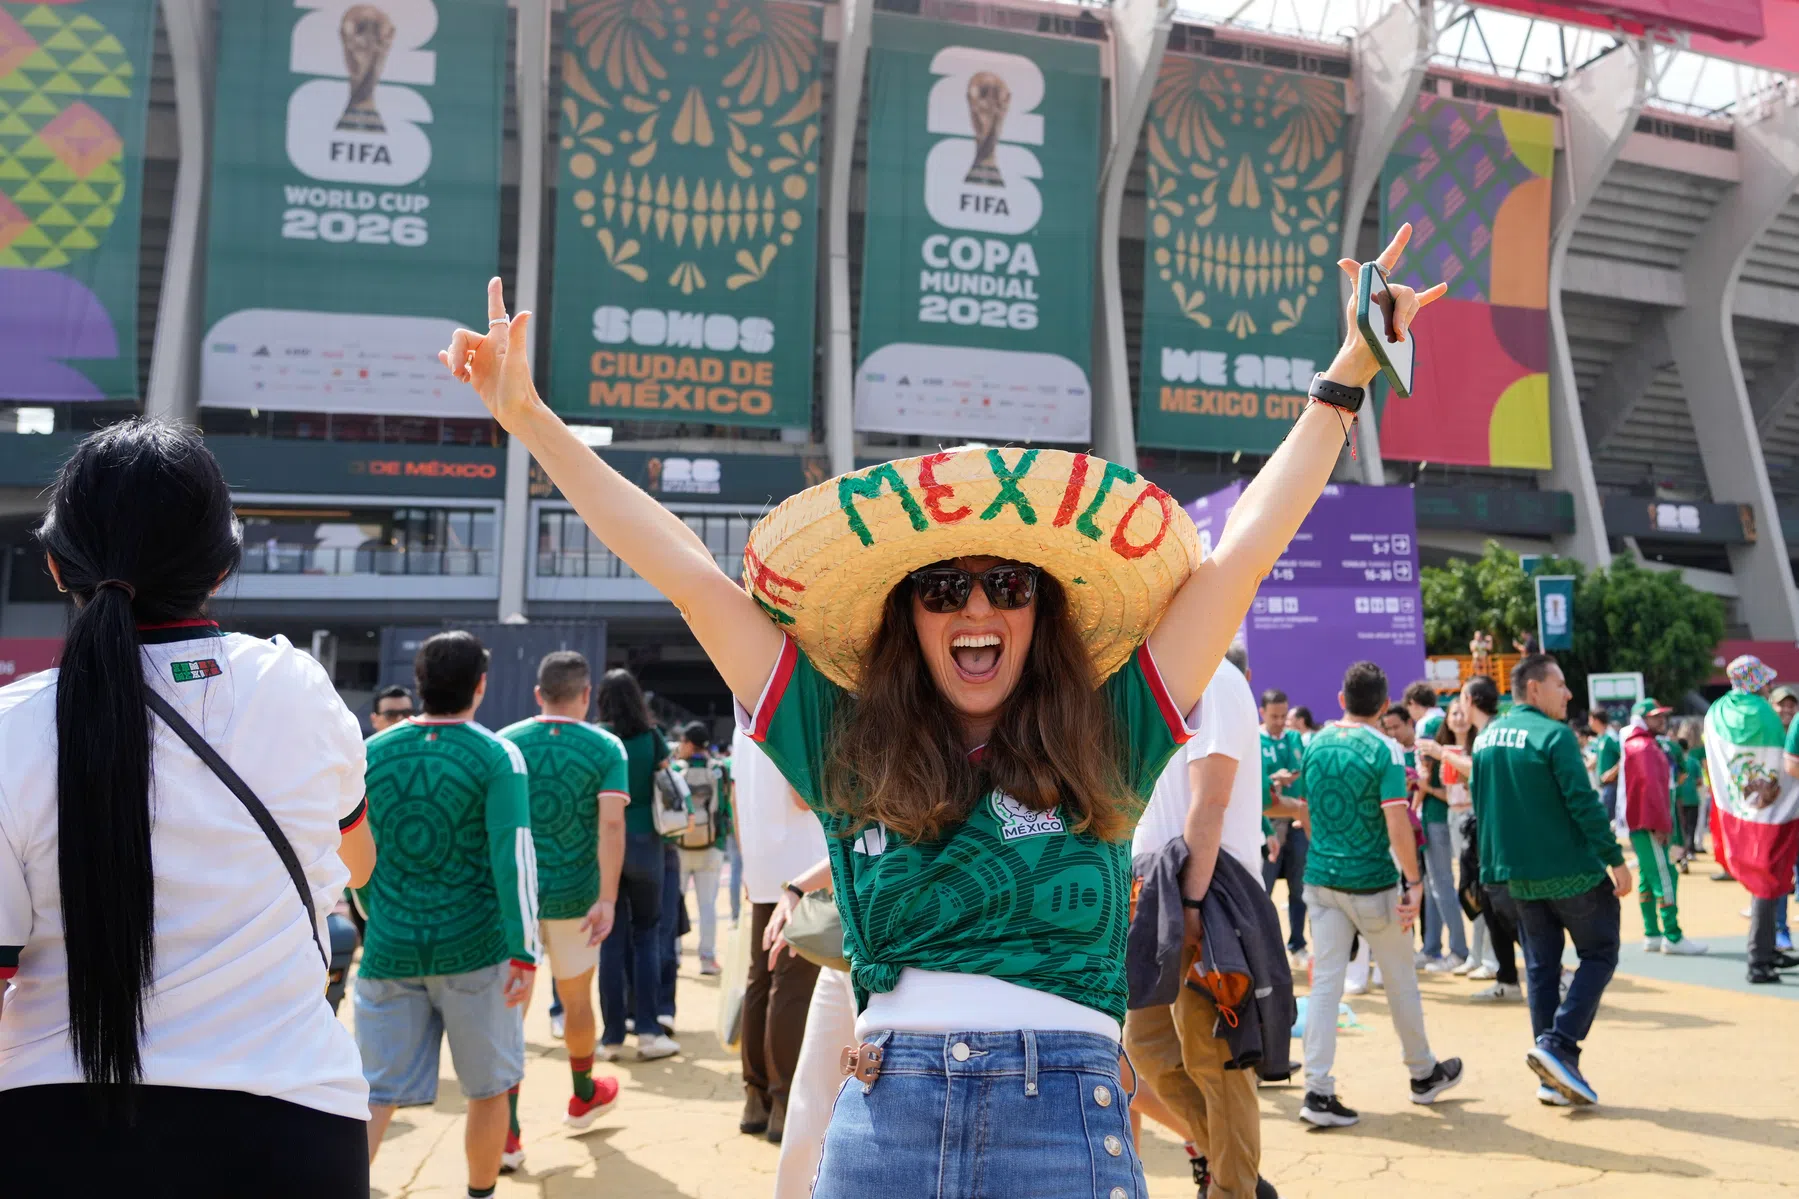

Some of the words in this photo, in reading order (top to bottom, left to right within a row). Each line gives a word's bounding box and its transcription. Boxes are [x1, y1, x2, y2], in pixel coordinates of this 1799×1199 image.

[330, 142, 392, 165] FIFA
[284, 185, 377, 211] WORLD
[378, 192, 430, 213] CUP
[960, 194, 1010, 216] FIFA
[282, 208, 429, 247] 2026
[921, 234, 1040, 276] COPA
[920, 269, 1039, 300] MUNDIAL
[592, 305, 775, 354] SOMOS
[919, 295, 1039, 330] 2026
[591, 351, 725, 384] CIUDAD
[729, 359, 774, 386] DE
[1161, 347, 1228, 386] WE
[1234, 354, 1316, 392] ARE
[589, 378, 773, 415] MÉXICO
[1160, 387, 1259, 418] MEXICO
[1265, 393, 1308, 420] CIT
[369, 460, 399, 475] DE
[838, 447, 1172, 560] MEXICO
[1003, 821, 1061, 838] MÉXICO
